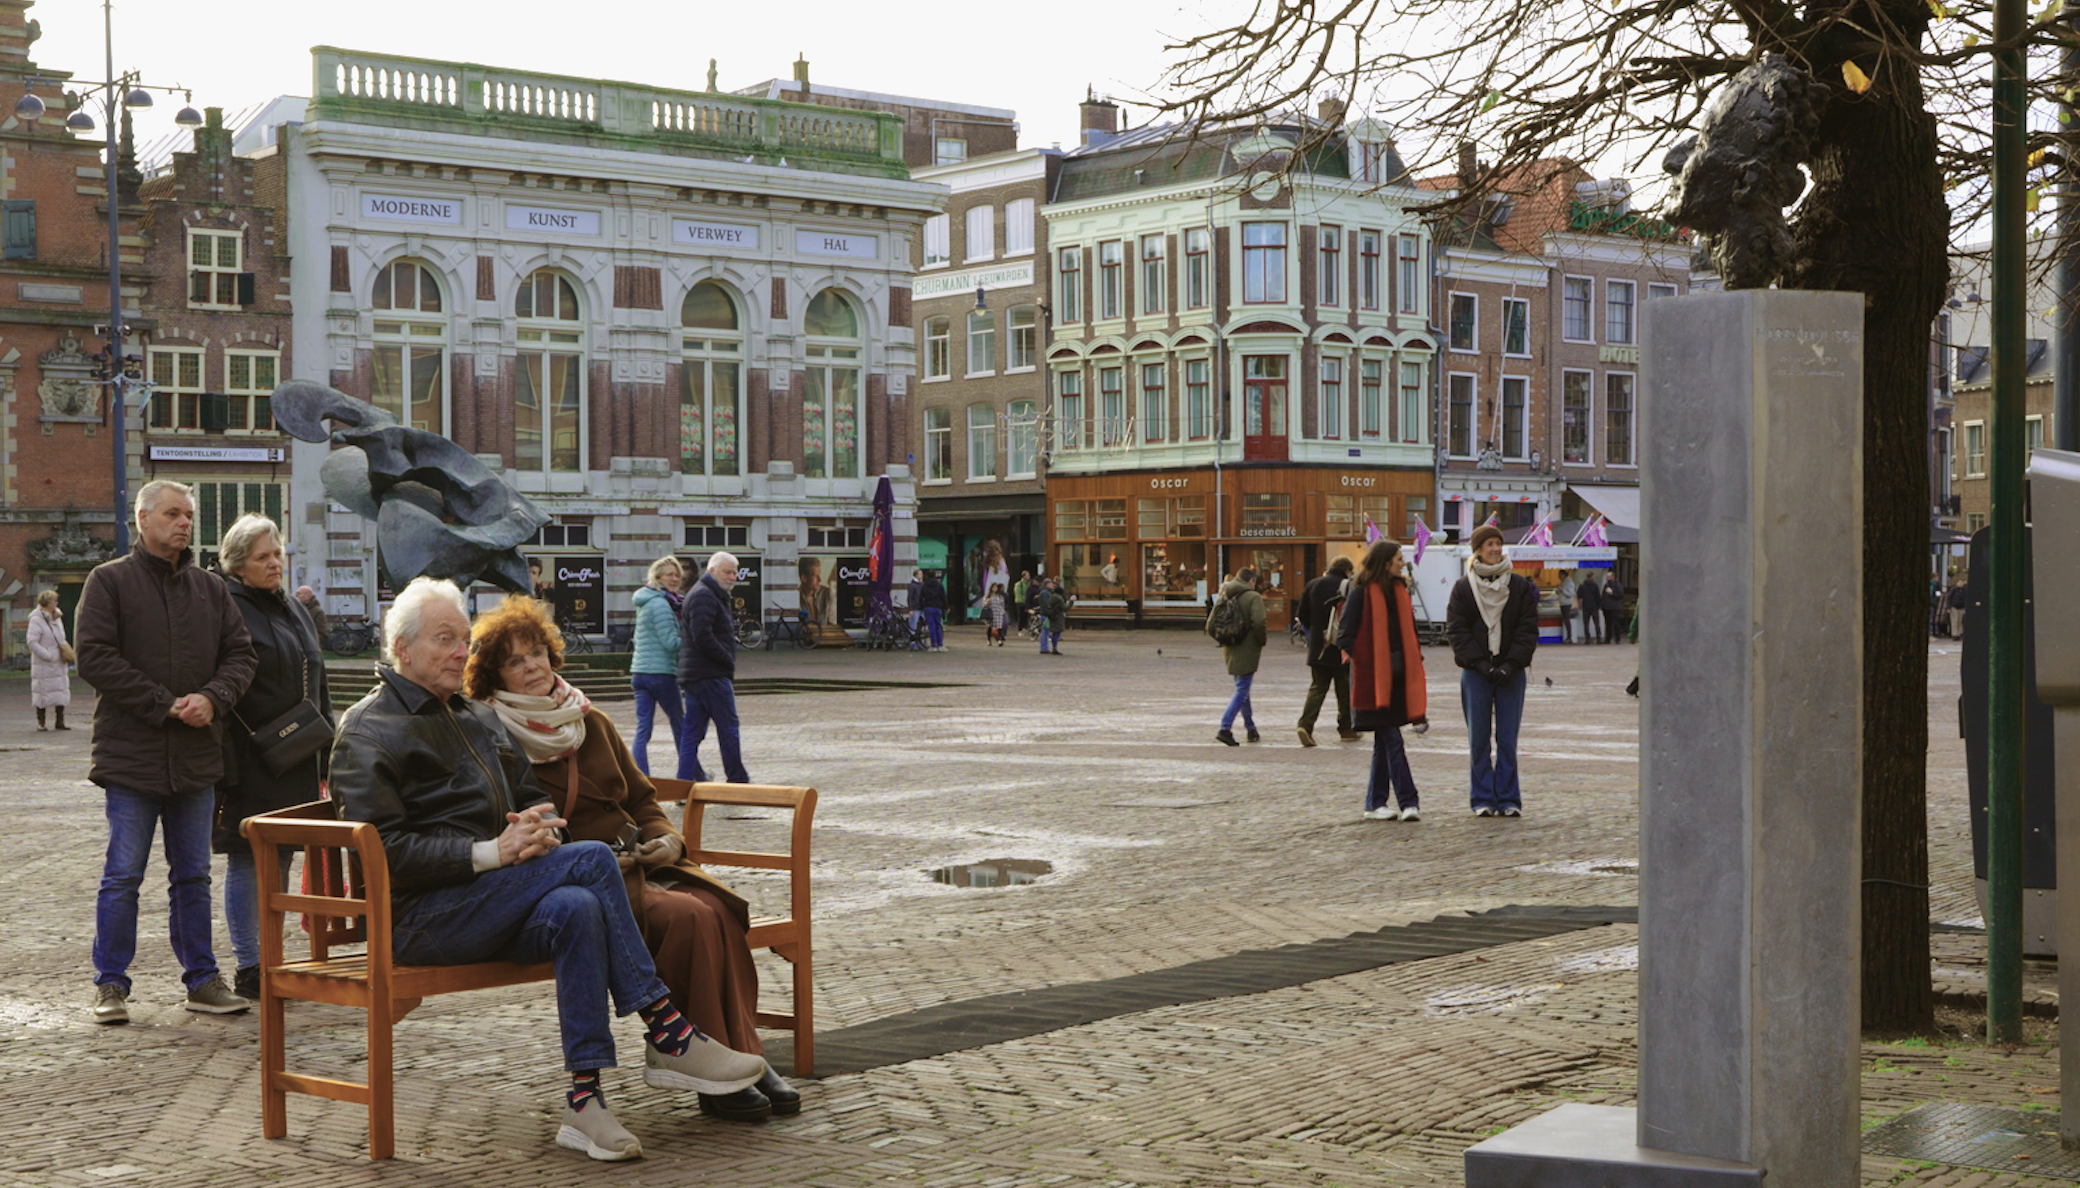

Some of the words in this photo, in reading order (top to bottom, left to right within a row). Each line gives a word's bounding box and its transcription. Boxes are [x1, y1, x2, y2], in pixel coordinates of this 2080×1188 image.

[371, 199, 451, 218] MODERNE
[528, 212, 577, 228] KUNST
[688, 226, 742, 242] VERWEY
[823, 238, 849, 251] HAL
[912, 274, 972, 296] CHURMANN
[973, 268, 1028, 286] LEEUWARDEN
[1600, 346, 1639, 364] HOTE
[156, 449, 222, 458] TENTOONSTELLING
[1151, 478, 1189, 489] Oscar
[1341, 475, 1376, 487] Oscar
[1240, 525, 1297, 537] Desemcafé
